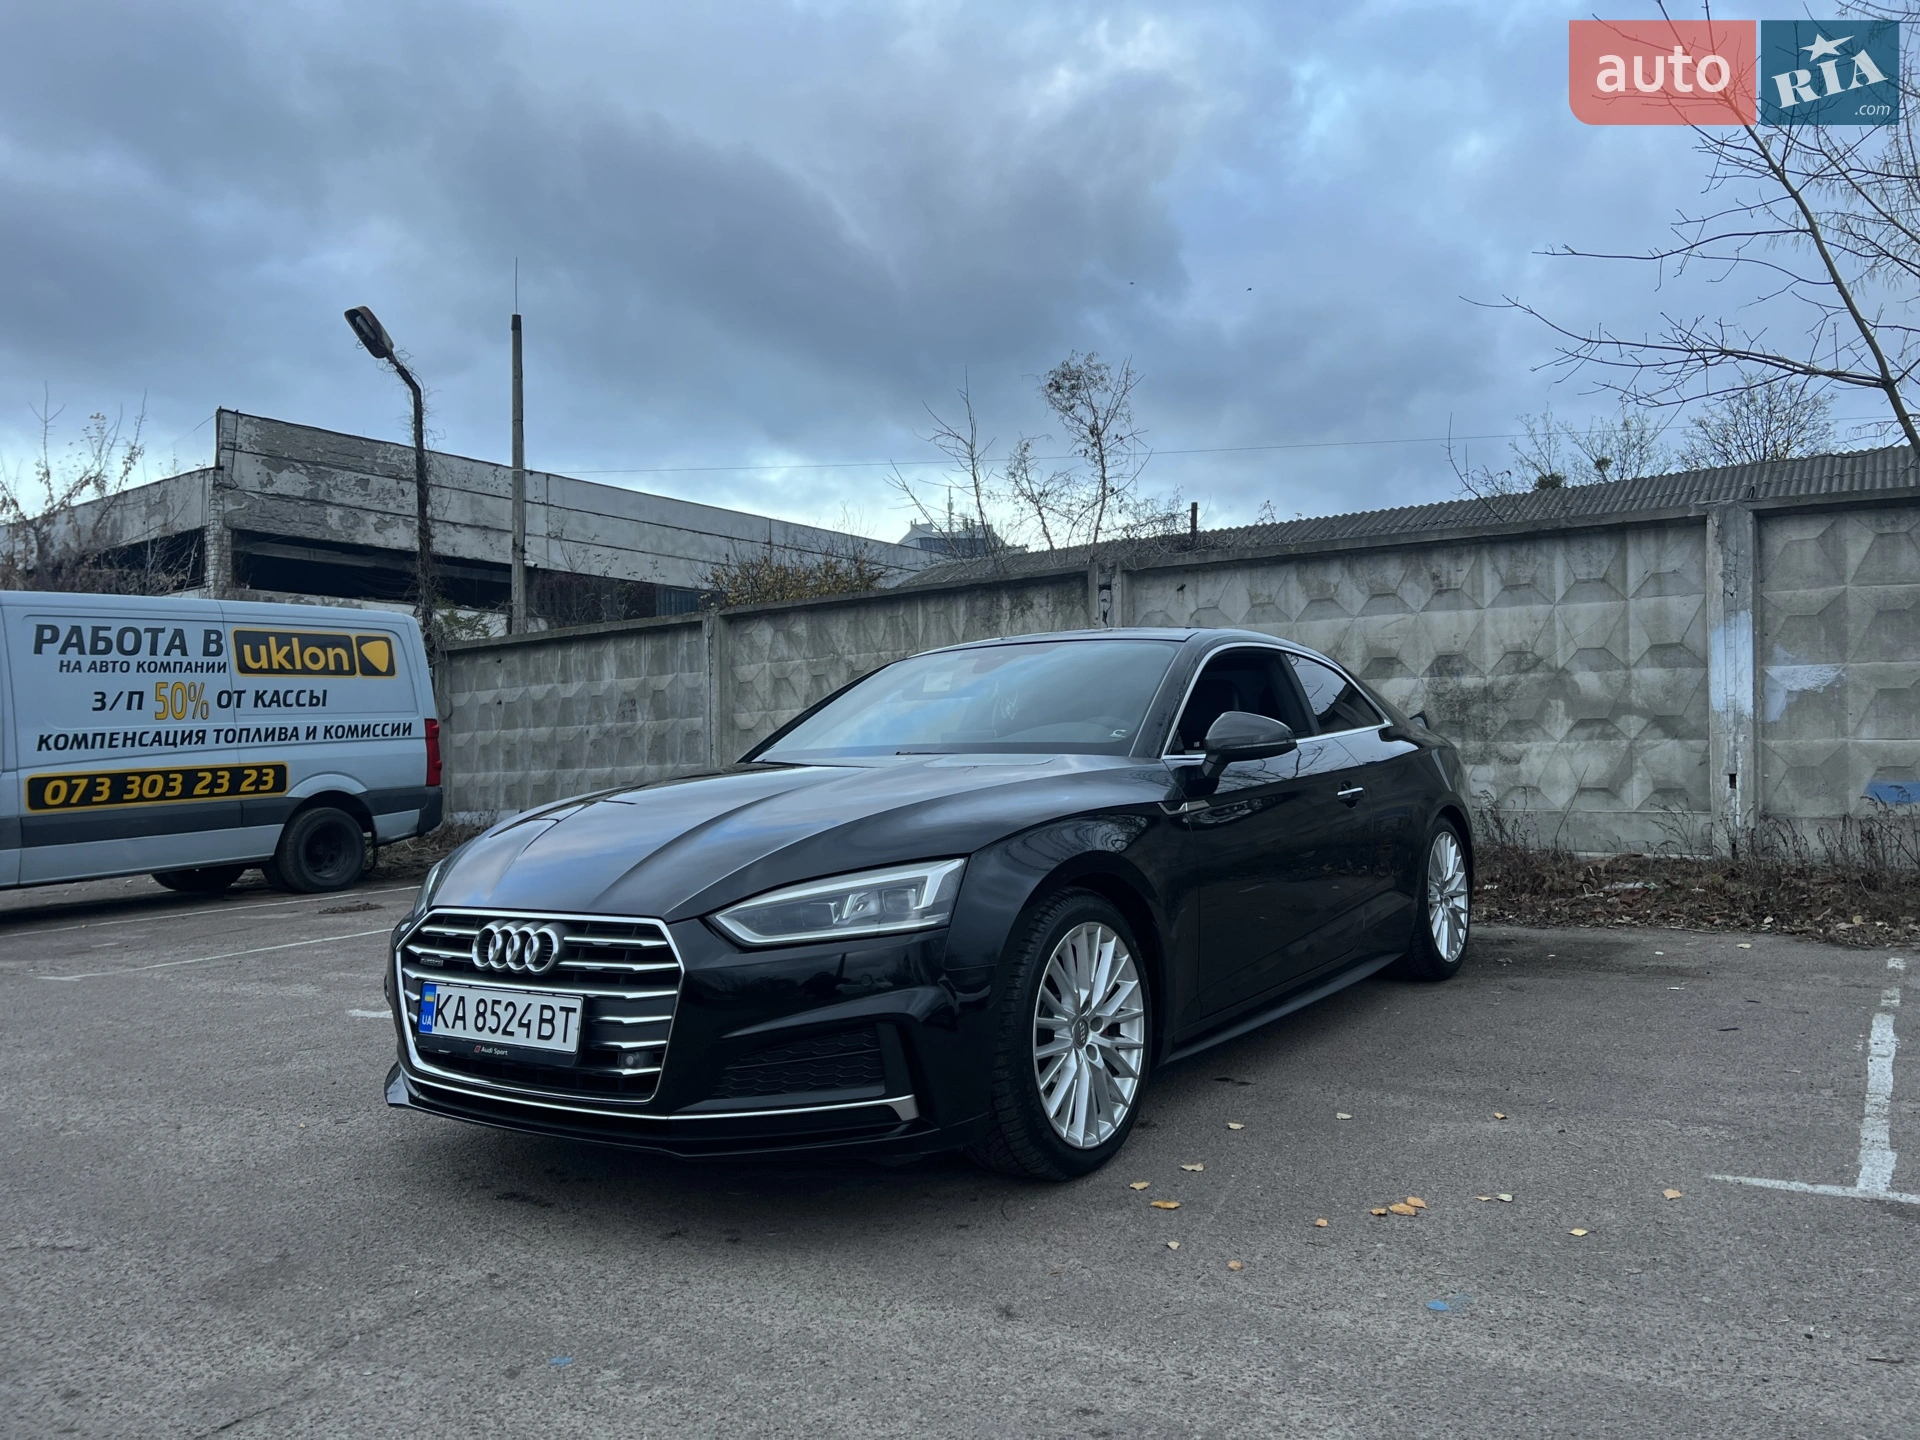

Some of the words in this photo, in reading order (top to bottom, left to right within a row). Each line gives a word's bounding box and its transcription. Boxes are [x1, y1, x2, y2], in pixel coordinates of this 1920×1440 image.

[33, 624, 189, 656] РАБОТА
[202, 629, 224, 657] В
[243, 636, 350, 671] uklon
[59, 660, 82, 673] НА
[87, 660, 130, 673] АВТО
[135, 661, 227, 674] КОМПАНИИ
[155, 681, 209, 720] 50%
[216, 689, 246, 709] ОТ
[253, 689, 327, 708] КАССЫ
[37, 729, 206, 751] КОМПЕНСАЦИЯ
[213, 727, 299, 744] ТОПЛИВА
[305, 726, 317, 740] И
[323, 722, 412, 739] КОМИССИИ
[44, 778, 111, 806] 073
[123, 774, 183, 800] 303
[193, 770, 230, 796] 23
[239, 768, 275, 792] 23
[421, 1014, 432, 1026] UA
[480, 1046, 493, 1054] Audi
[493, 1047, 508, 1056] Sport
